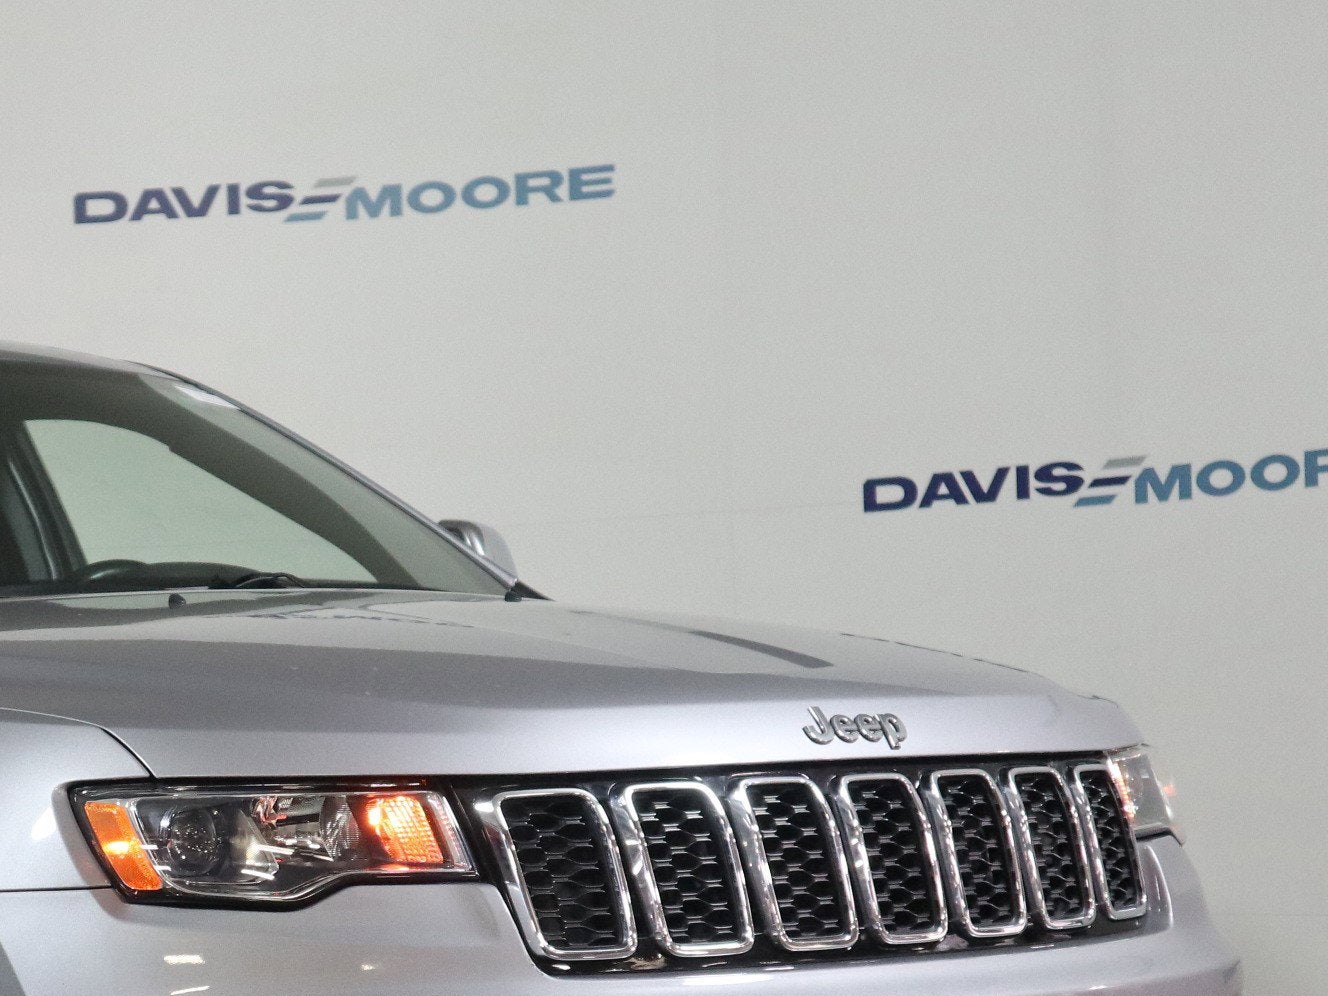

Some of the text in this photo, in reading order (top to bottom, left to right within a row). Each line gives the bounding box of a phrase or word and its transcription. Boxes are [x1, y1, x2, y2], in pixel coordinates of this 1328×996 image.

[73, 164, 615, 224] DAVIS MOORE
[863, 461, 1085, 513] DAVIS
[802, 706, 908, 750] Jeep
